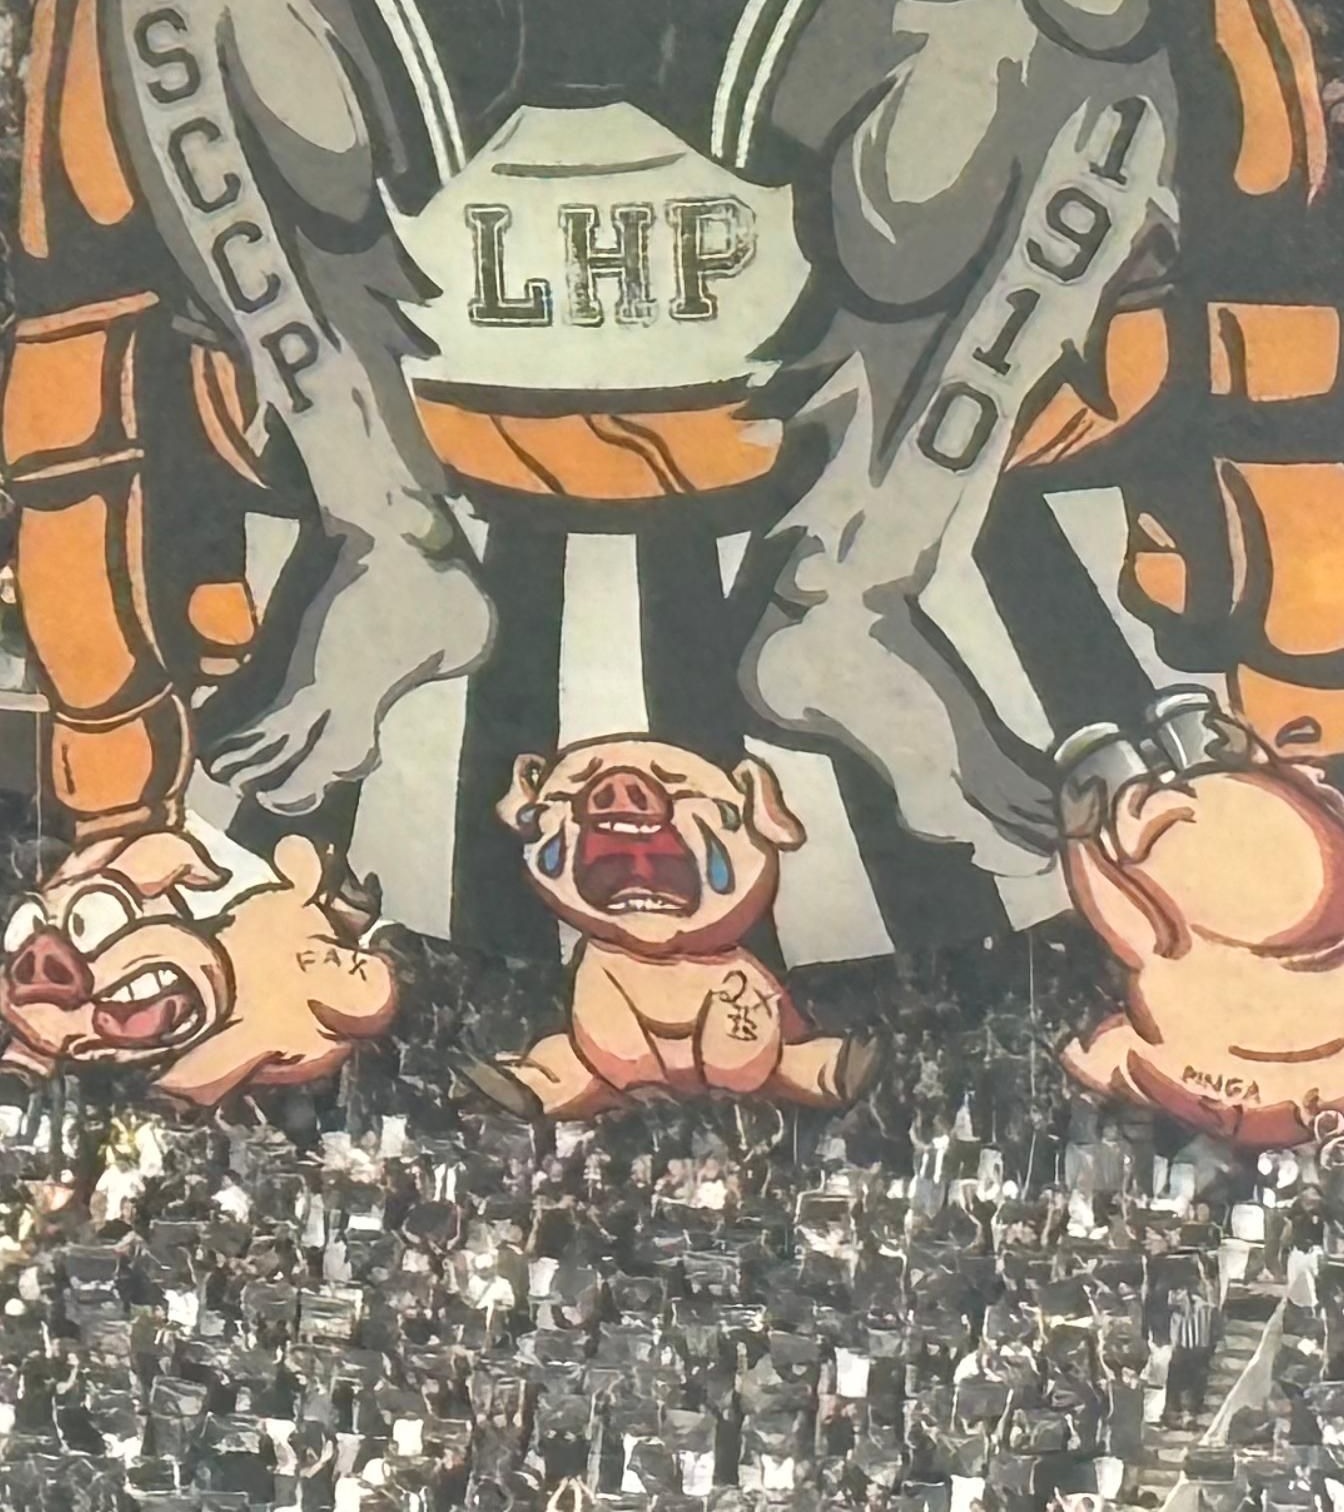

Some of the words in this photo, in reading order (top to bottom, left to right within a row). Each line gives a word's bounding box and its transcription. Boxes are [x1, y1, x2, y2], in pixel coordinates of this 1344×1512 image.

[133, 7, 320, 414] SCCP
[463, 194, 758, 328] LHP
[915, 95, 1147, 474] 1910
[1180, 1064, 1262, 1105] PINGA
